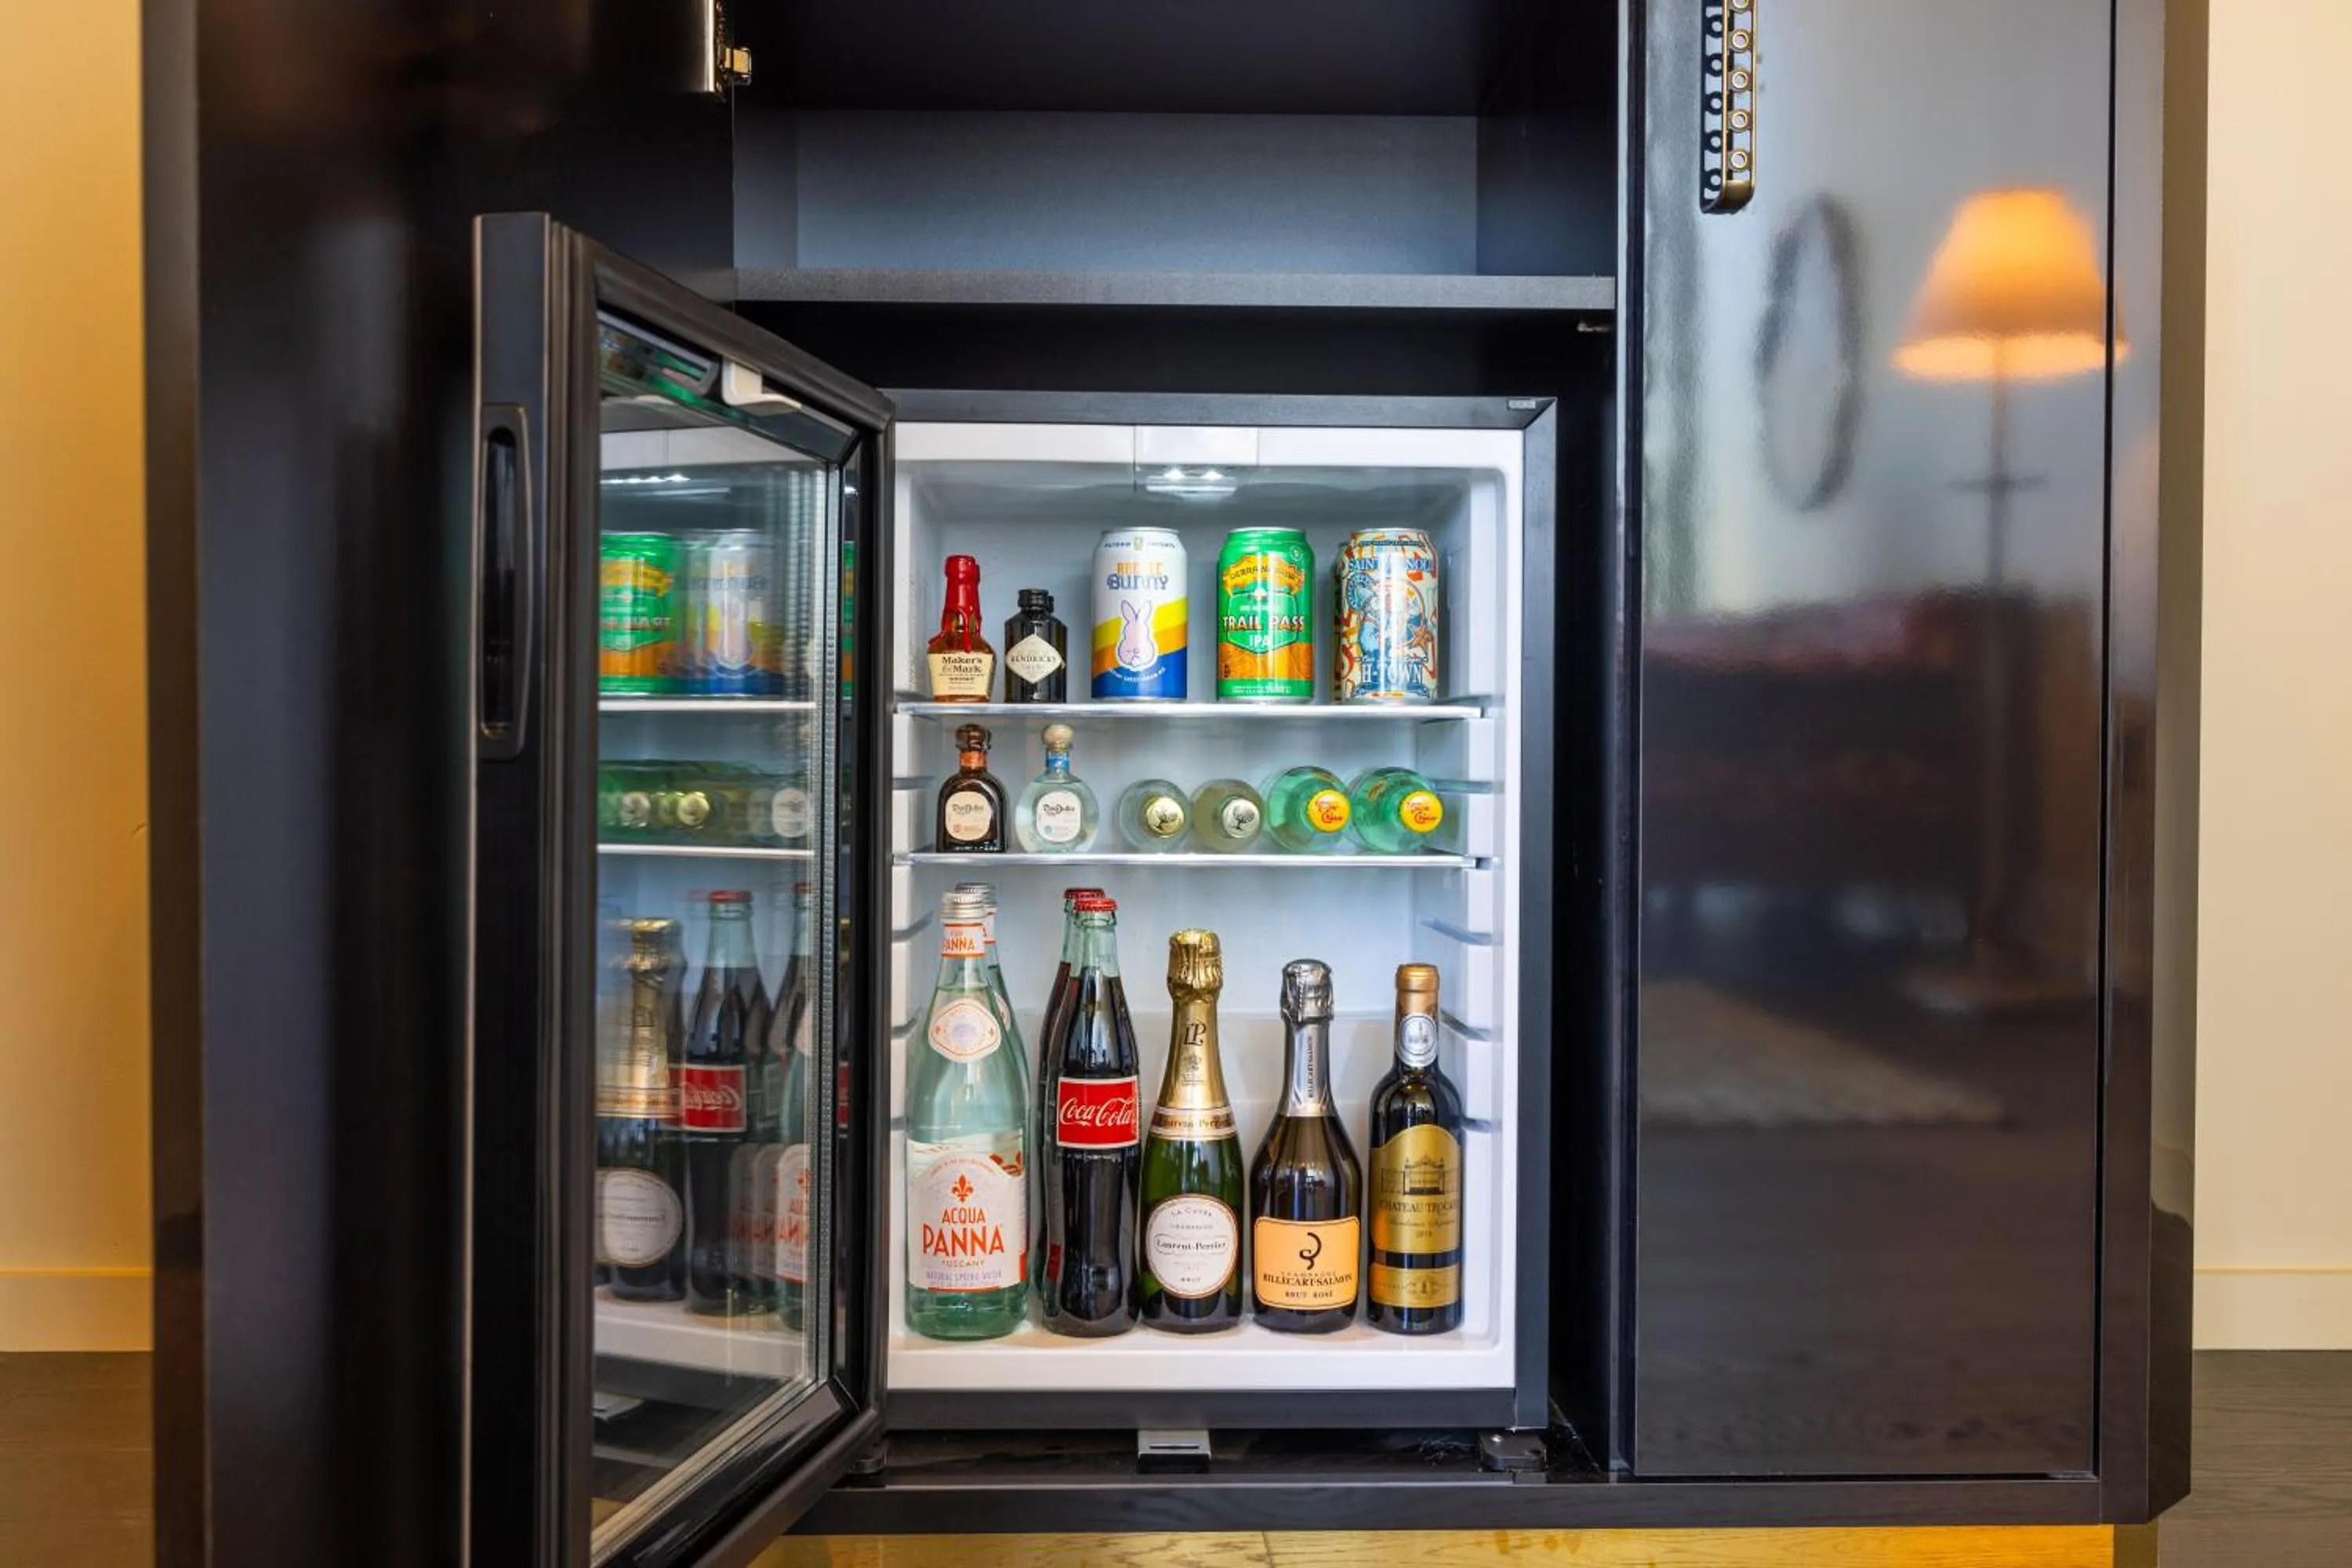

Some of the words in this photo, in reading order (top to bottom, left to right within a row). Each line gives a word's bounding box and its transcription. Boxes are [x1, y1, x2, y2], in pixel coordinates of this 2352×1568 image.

[1222, 614, 1262, 631] TRAIL
[1269, 614, 1305, 631] PASS
[1249, 633, 1272, 648] IPA
[952, 664, 983, 674] Mark
[1059, 1097, 1134, 1127] Coca-Cola
[942, 1207, 986, 1224] ACQUA
[922, 1223, 1004, 1256] PANNA
